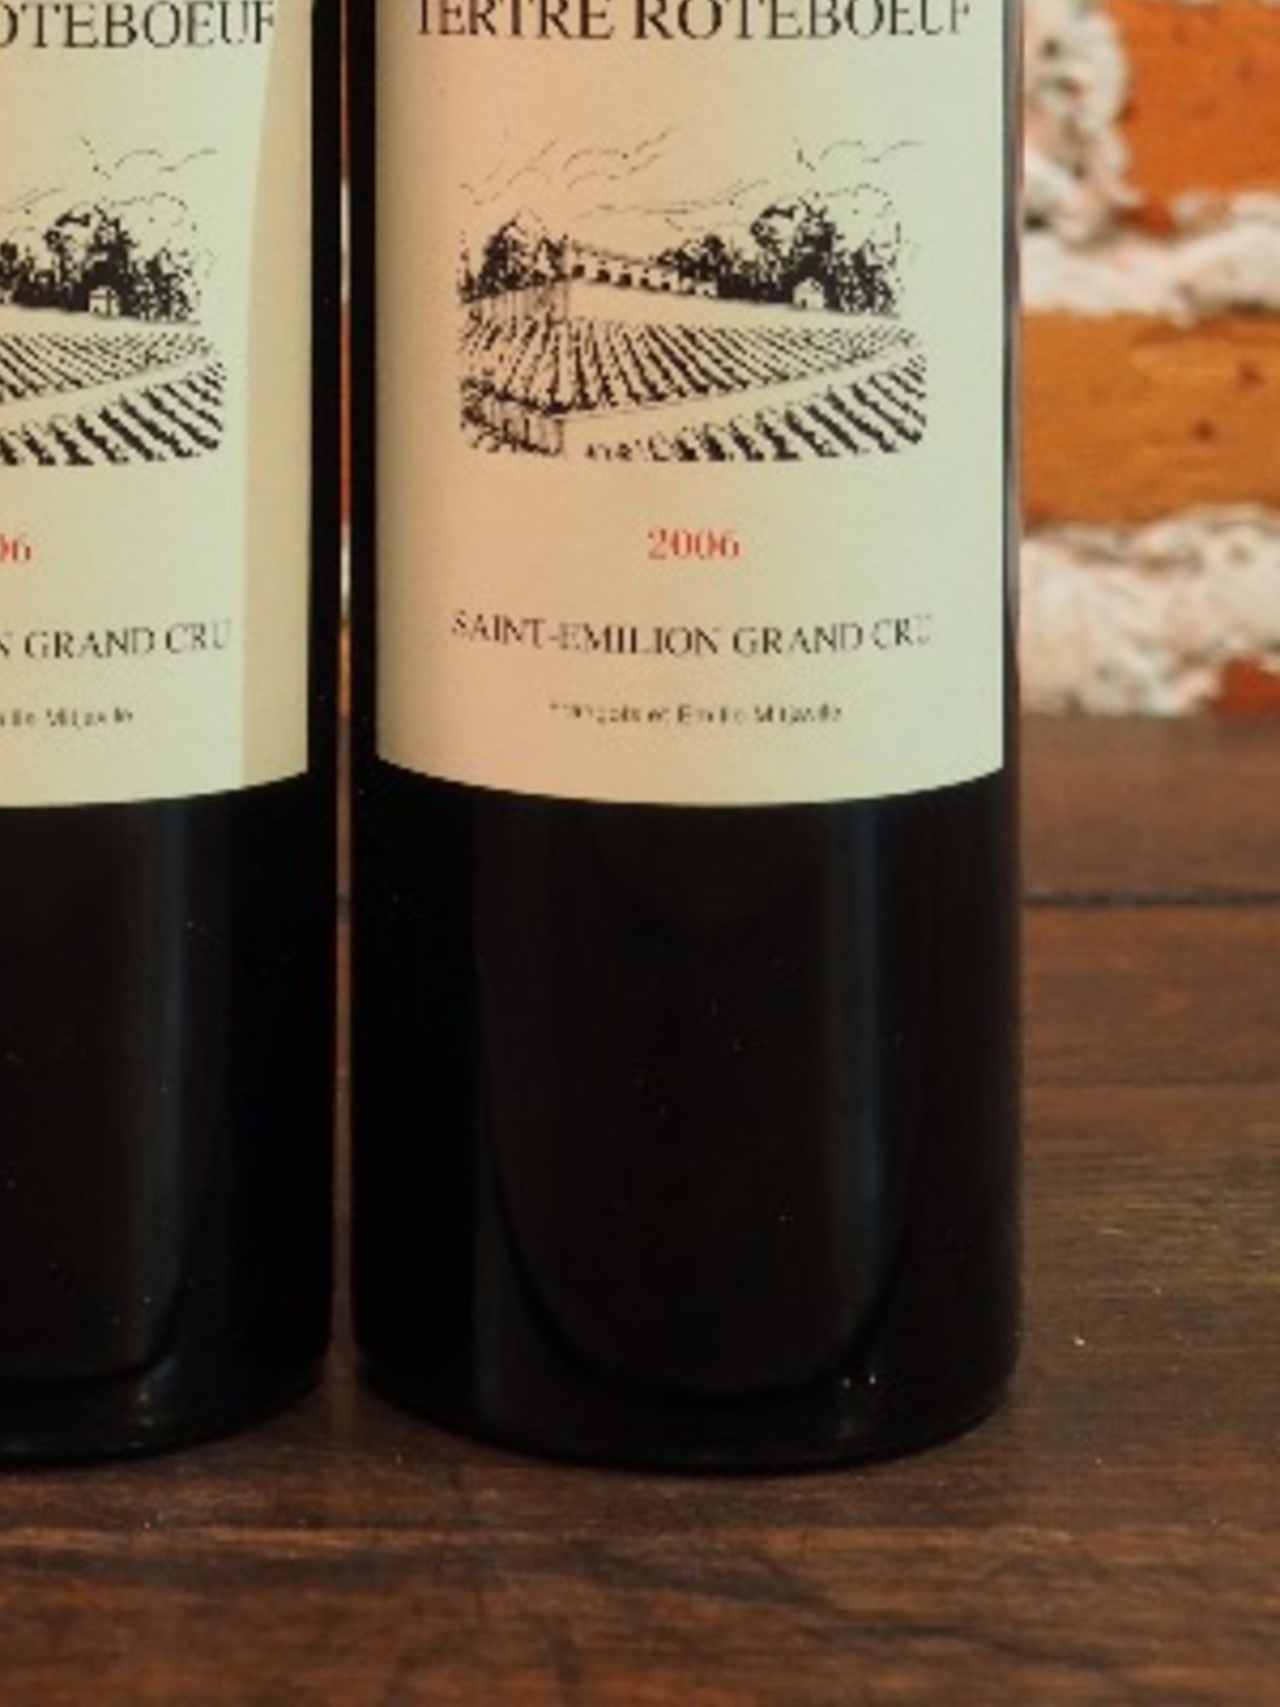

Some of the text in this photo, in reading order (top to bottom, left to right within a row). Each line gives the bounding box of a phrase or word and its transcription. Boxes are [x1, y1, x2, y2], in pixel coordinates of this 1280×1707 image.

[646, 528, 740, 560] 2006
[23, 625, 157, 660] GRAND
[163, 619, 232, 655] CRU
[451, 609, 933, 656] SAINT-EMILION GRAND CRU
